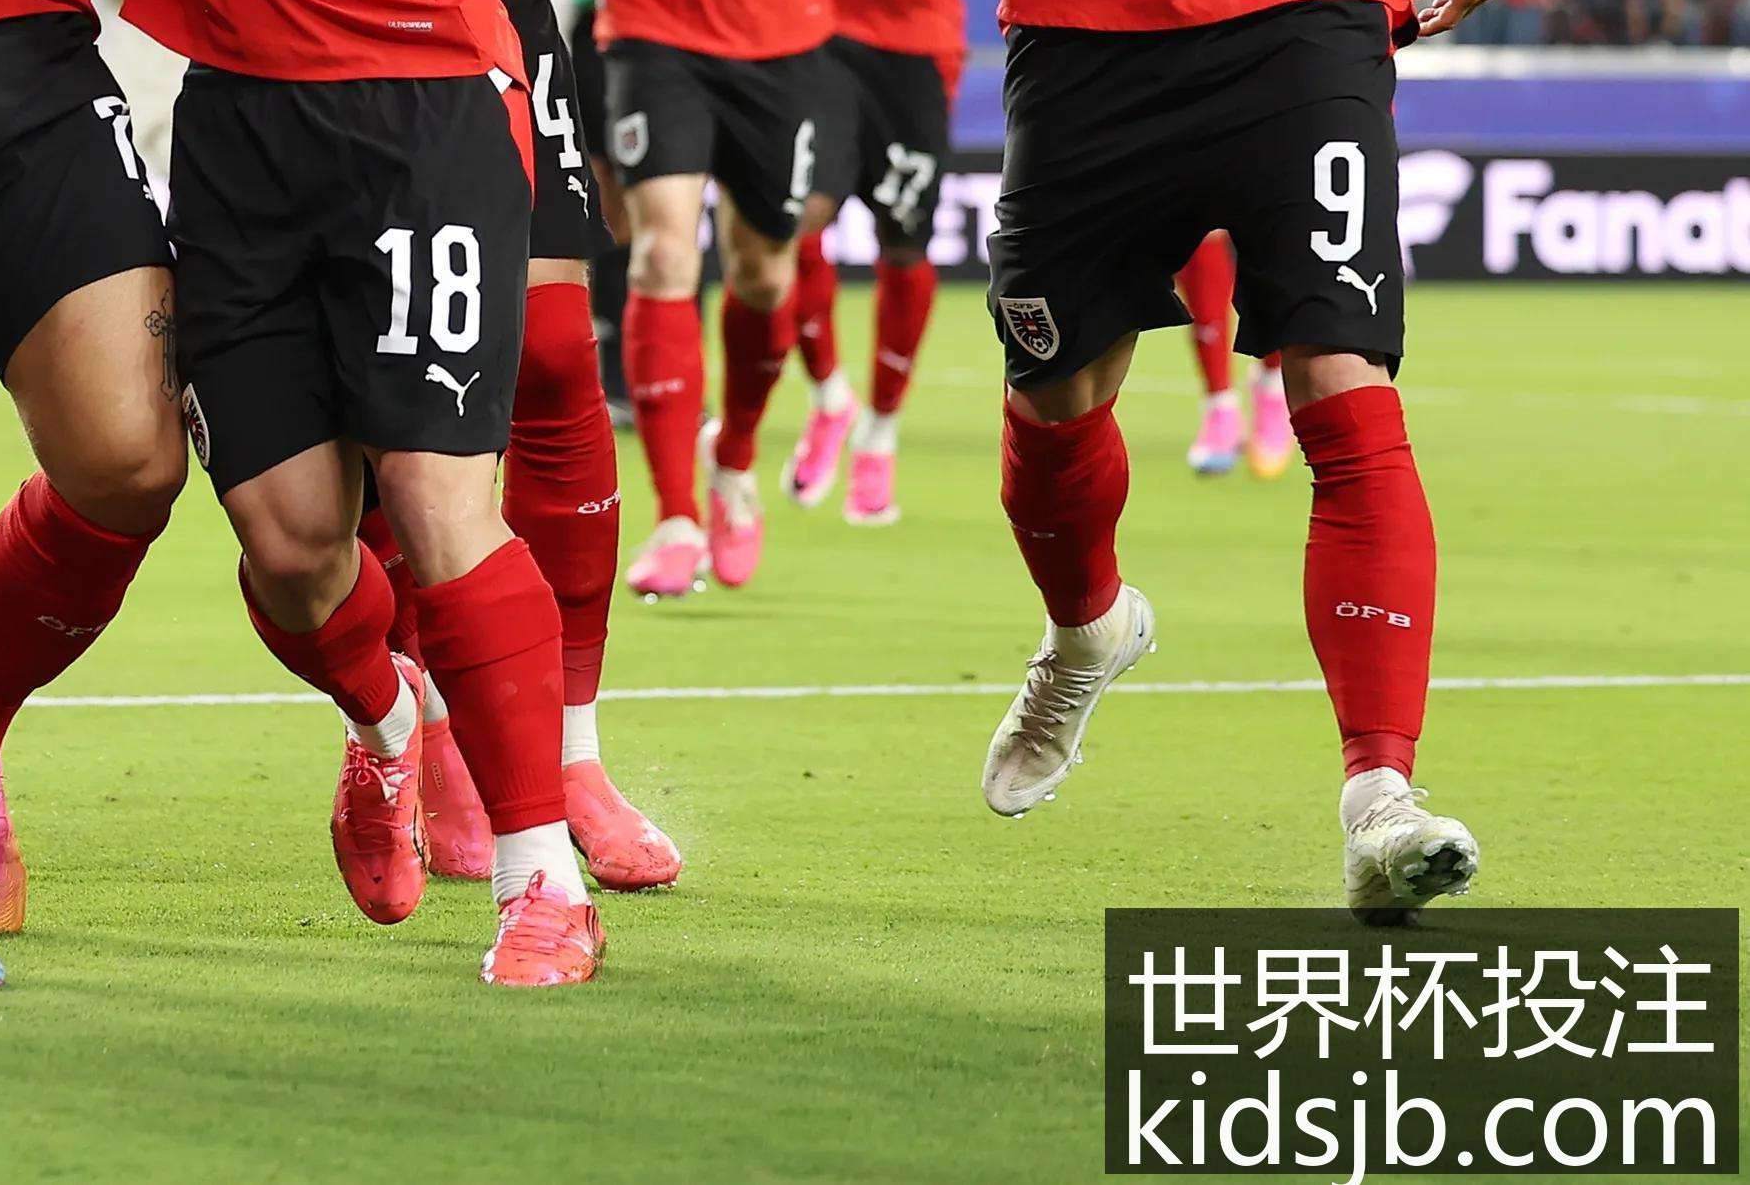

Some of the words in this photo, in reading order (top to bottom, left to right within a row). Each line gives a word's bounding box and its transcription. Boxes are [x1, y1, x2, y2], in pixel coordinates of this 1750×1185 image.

[93, 95, 139, 179] 7
[533, 53, 583, 169] 4
[1310, 141, 1366, 263] 9
[375, 224, 482, 355] 18
[1335, 601, 1412, 628] ÖFB
